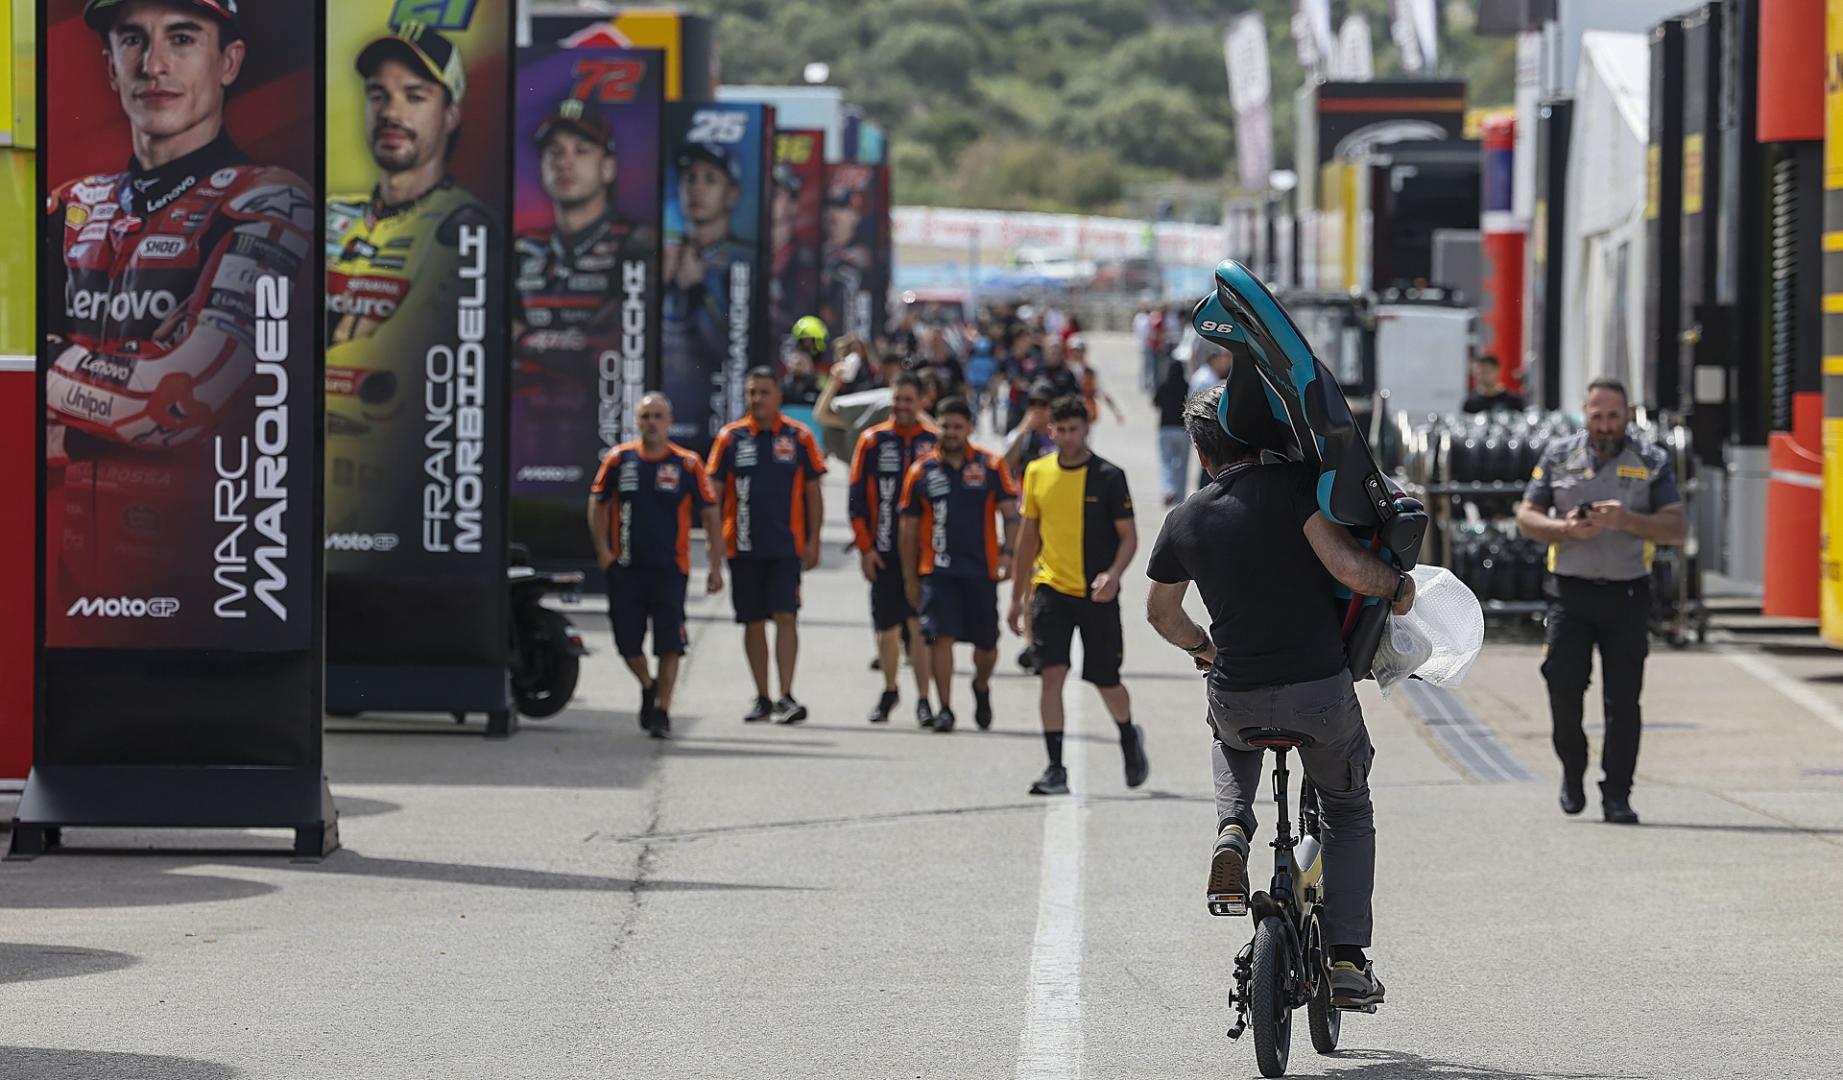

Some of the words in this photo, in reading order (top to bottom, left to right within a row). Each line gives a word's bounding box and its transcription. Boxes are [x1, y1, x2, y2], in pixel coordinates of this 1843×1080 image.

[576, 61, 643, 101] 72
[686, 110, 749, 143] 25
[146, 175, 196, 212] Lenovo
[145, 240, 181, 254] SHOEI
[65, 288, 177, 322] Lenovo
[1200, 320, 1234, 334] 96
[81, 353, 129, 380] Lenovo
[622, 260, 646, 442] ZZECCHI
[67, 385, 114, 417] Unipol
[454, 225, 488, 552] MORBIDELLI
[254, 275, 289, 622] MARQUEZ
[423, 345, 454, 552] FRANCO
[214, 435, 248, 618] MARC
[66, 596, 180, 618] MotoGP
